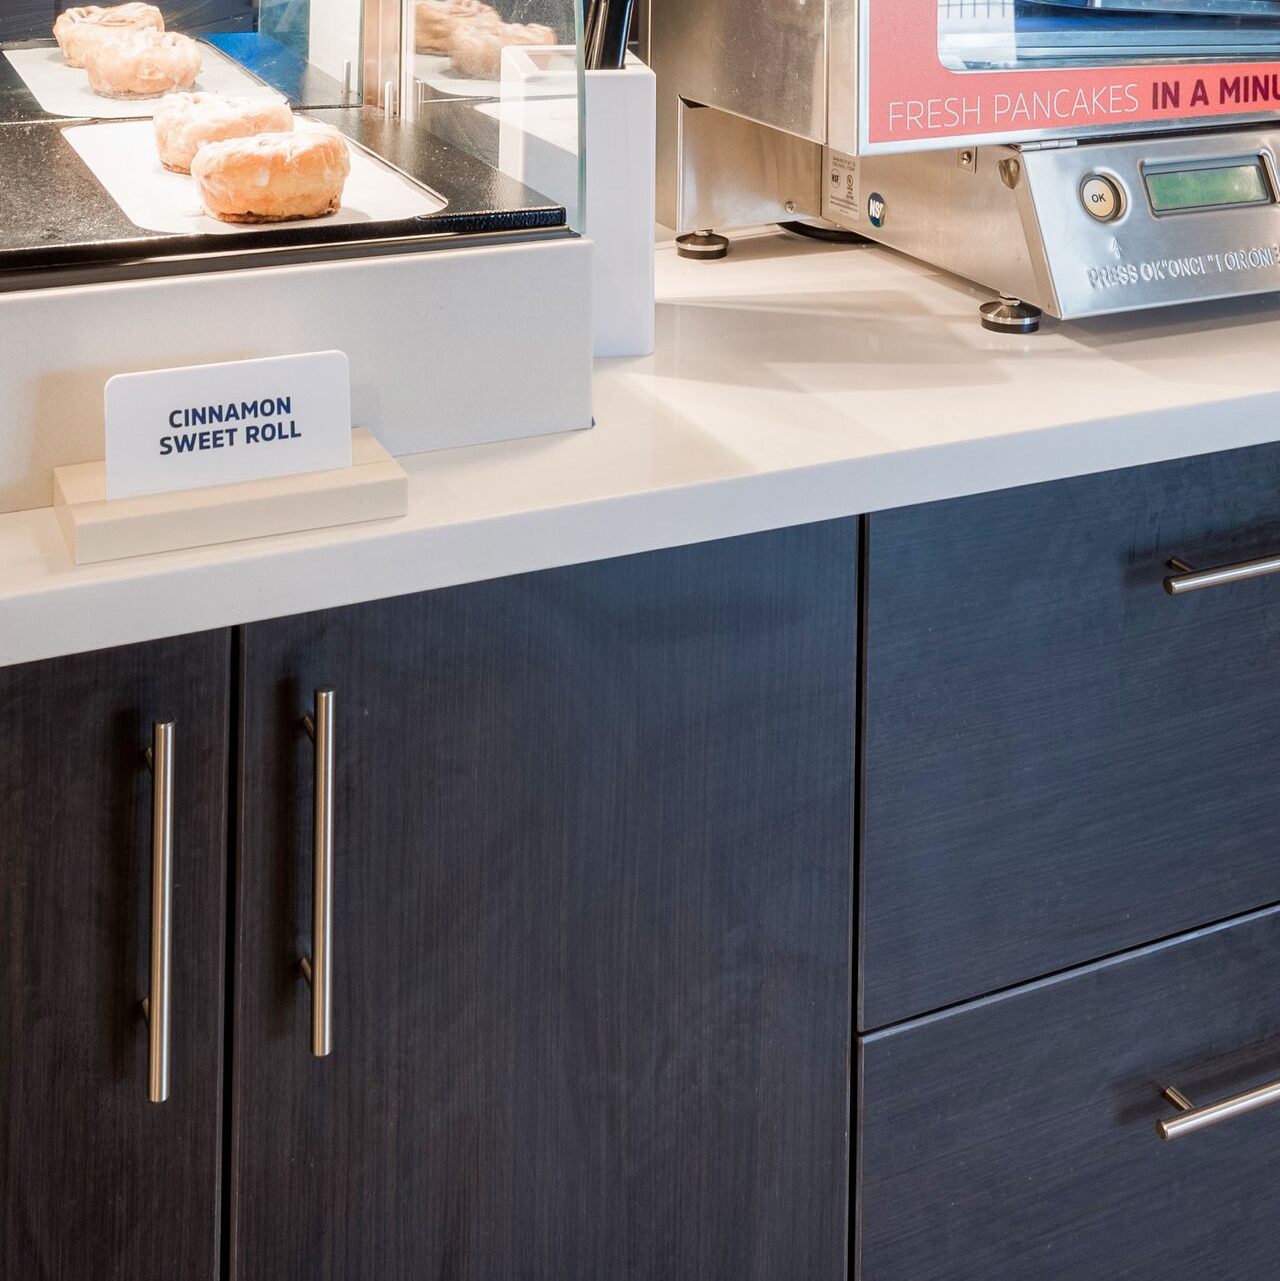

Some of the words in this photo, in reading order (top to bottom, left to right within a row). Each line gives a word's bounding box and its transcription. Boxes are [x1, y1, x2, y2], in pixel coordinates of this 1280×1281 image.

[888, 94, 981, 132] FRESH
[993, 83, 1140, 123] PANCAKES
[1151, 80, 1180, 110] IN
[1189, 78, 1210, 107] A
[1091, 193, 1106, 203] OK
[1086, 263, 1139, 289] PRESS
[1140, 260, 1164, 281] OK
[168, 396, 292, 429] CINNAMON
[159, 427, 238, 456] SWEET
[245, 420, 302, 445] ROLL
